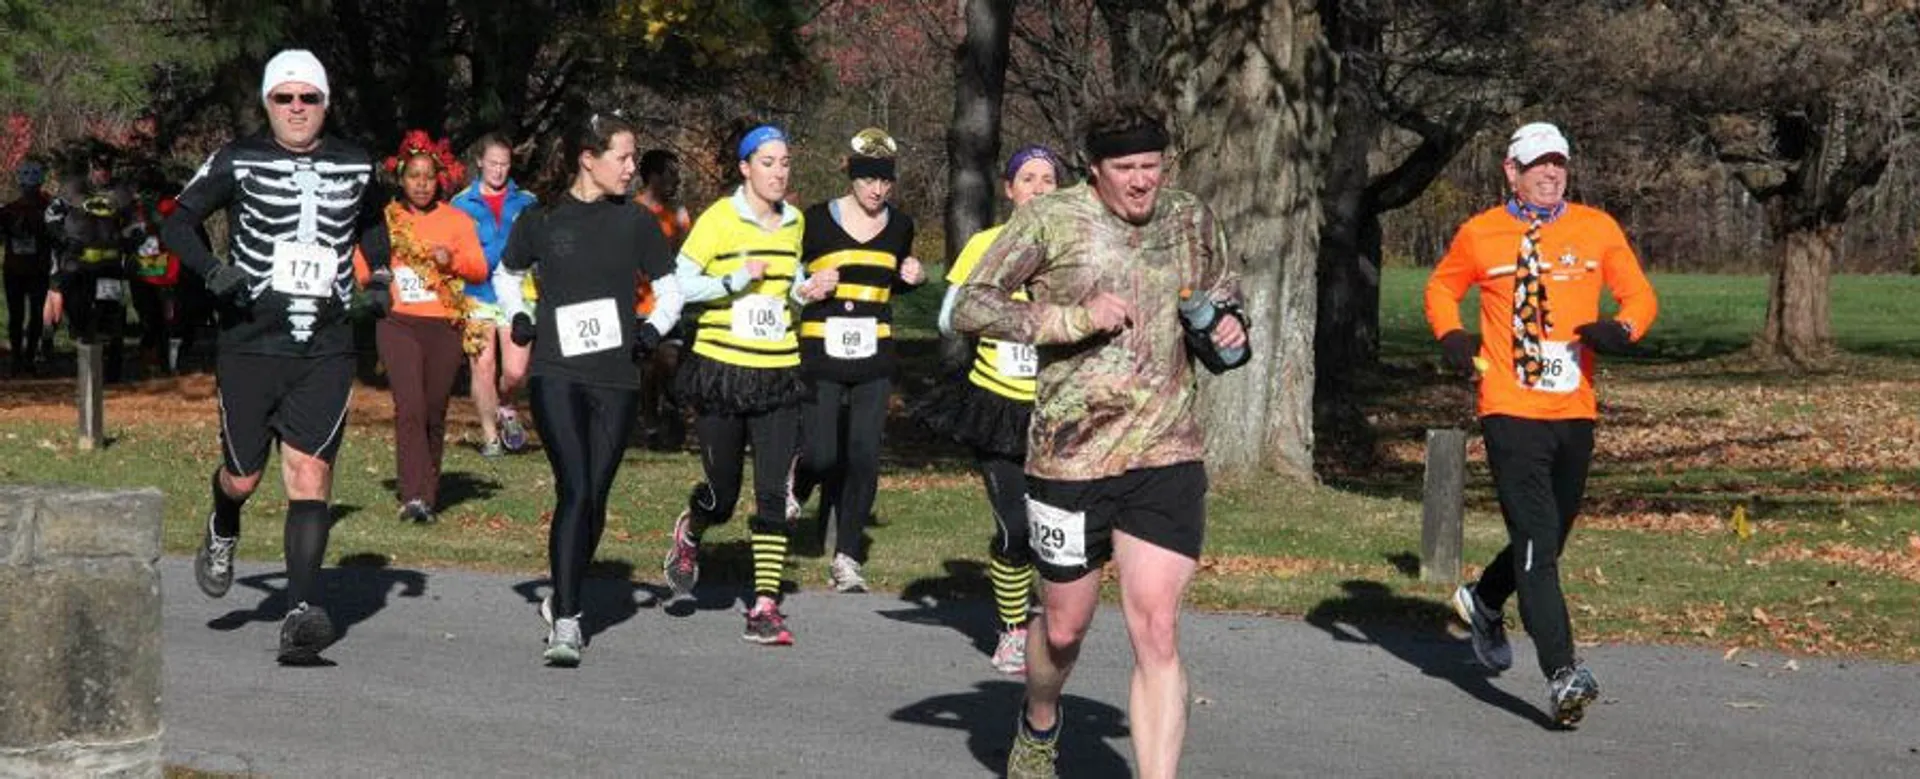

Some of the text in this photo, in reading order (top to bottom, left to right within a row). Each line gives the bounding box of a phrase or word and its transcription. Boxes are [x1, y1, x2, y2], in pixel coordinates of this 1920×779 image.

[290, 260, 320, 279] 171
[576, 317, 601, 338] 20
[1031, 521, 1066, 549] 129
